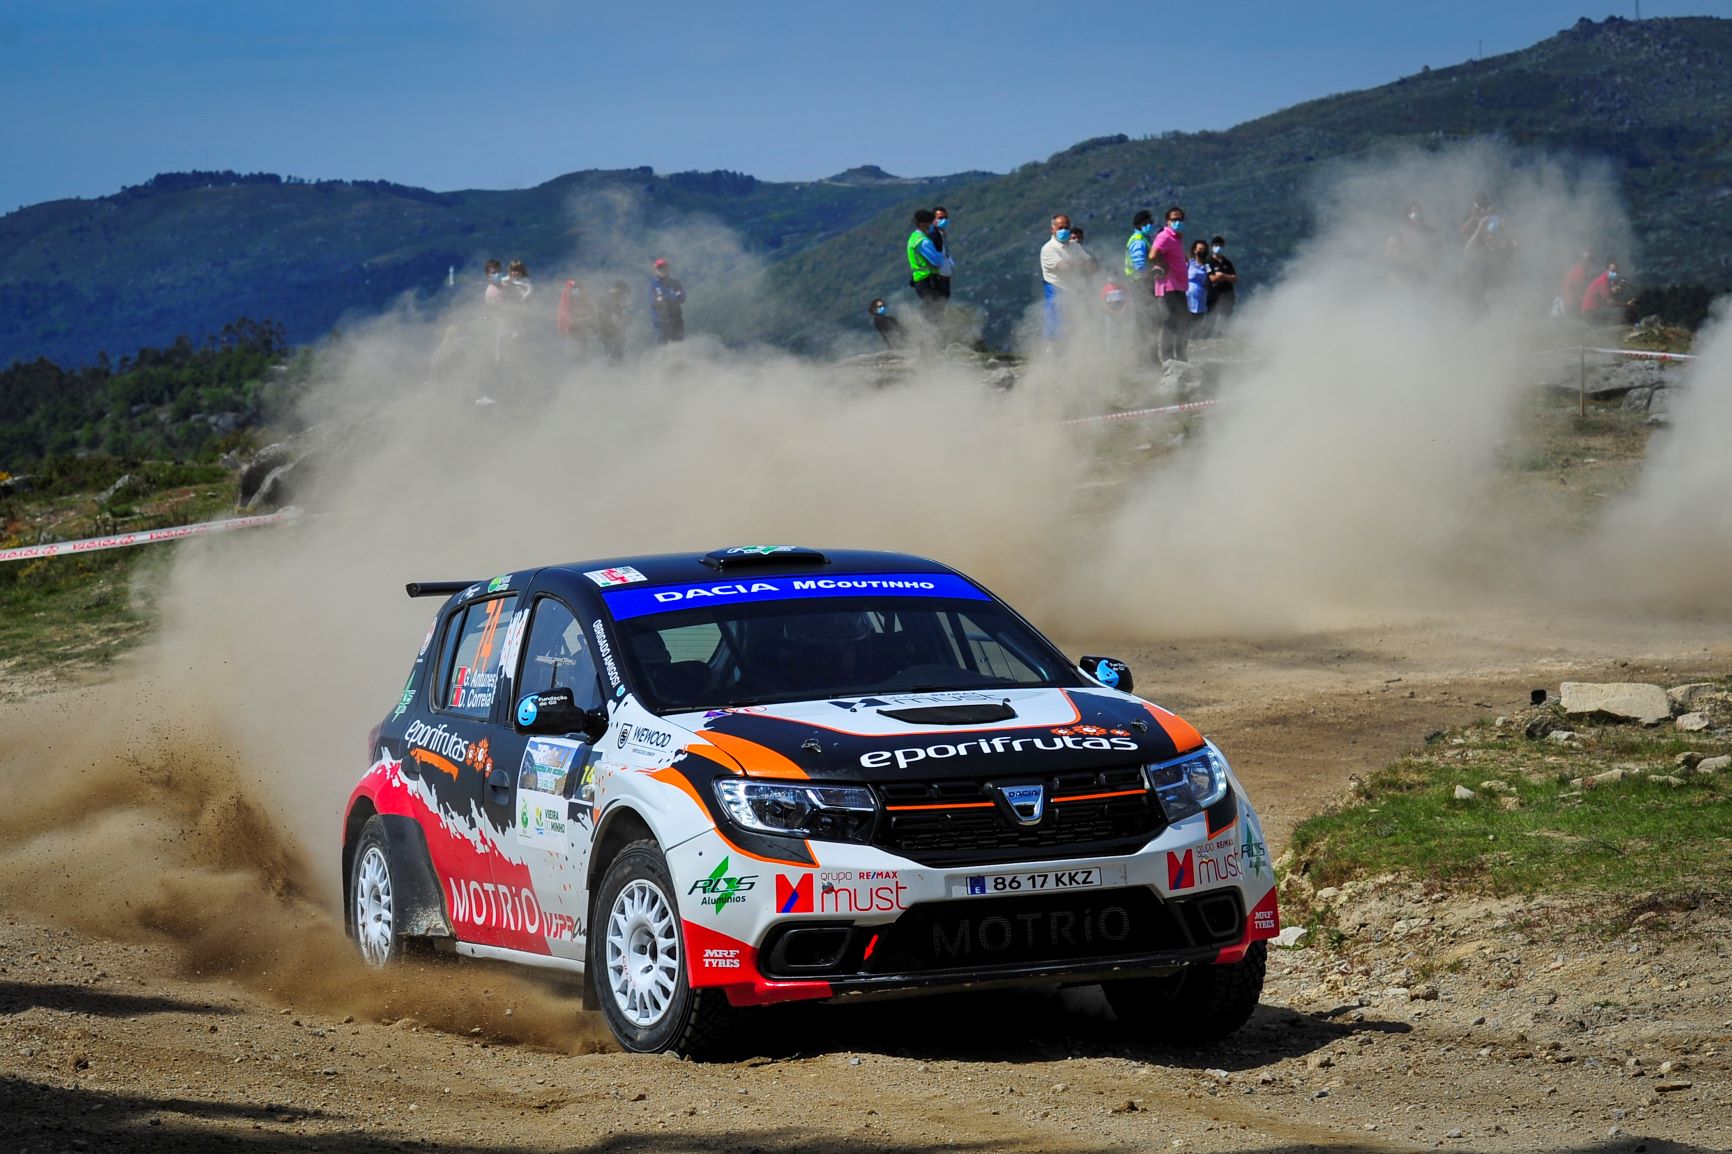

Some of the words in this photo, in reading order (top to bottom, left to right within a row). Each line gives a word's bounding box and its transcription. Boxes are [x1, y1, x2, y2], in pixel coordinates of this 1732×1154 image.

[653, 582, 779, 603] DACIA
[592, 619, 611, 657] OBRIGADO
[470, 667, 496, 688] Antunes
[457, 688, 466, 708] D.
[467, 688, 492, 708] Correia
[404, 719, 468, 763] eporifrutas
[632, 726, 672, 748] WEWOOD
[859, 735, 1139, 769] eporifrutas
[1008, 789, 1039, 798] DACIA
[820, 871, 853, 882] grupo
[858, 871, 898, 880] RE/MAX
[1198, 847, 1242, 885] must
[993, 875, 1022, 891] 86
[1026, 873, 1049, 889] 17
[1055, 870, 1094, 887] KKZ
[820, 880, 909, 913] must
[1254, 910, 1274, 920] MRF
[1254, 919, 1275, 930] TYRES
[703, 949, 741, 958] MRF
[703, 958, 741, 968] TYRES
